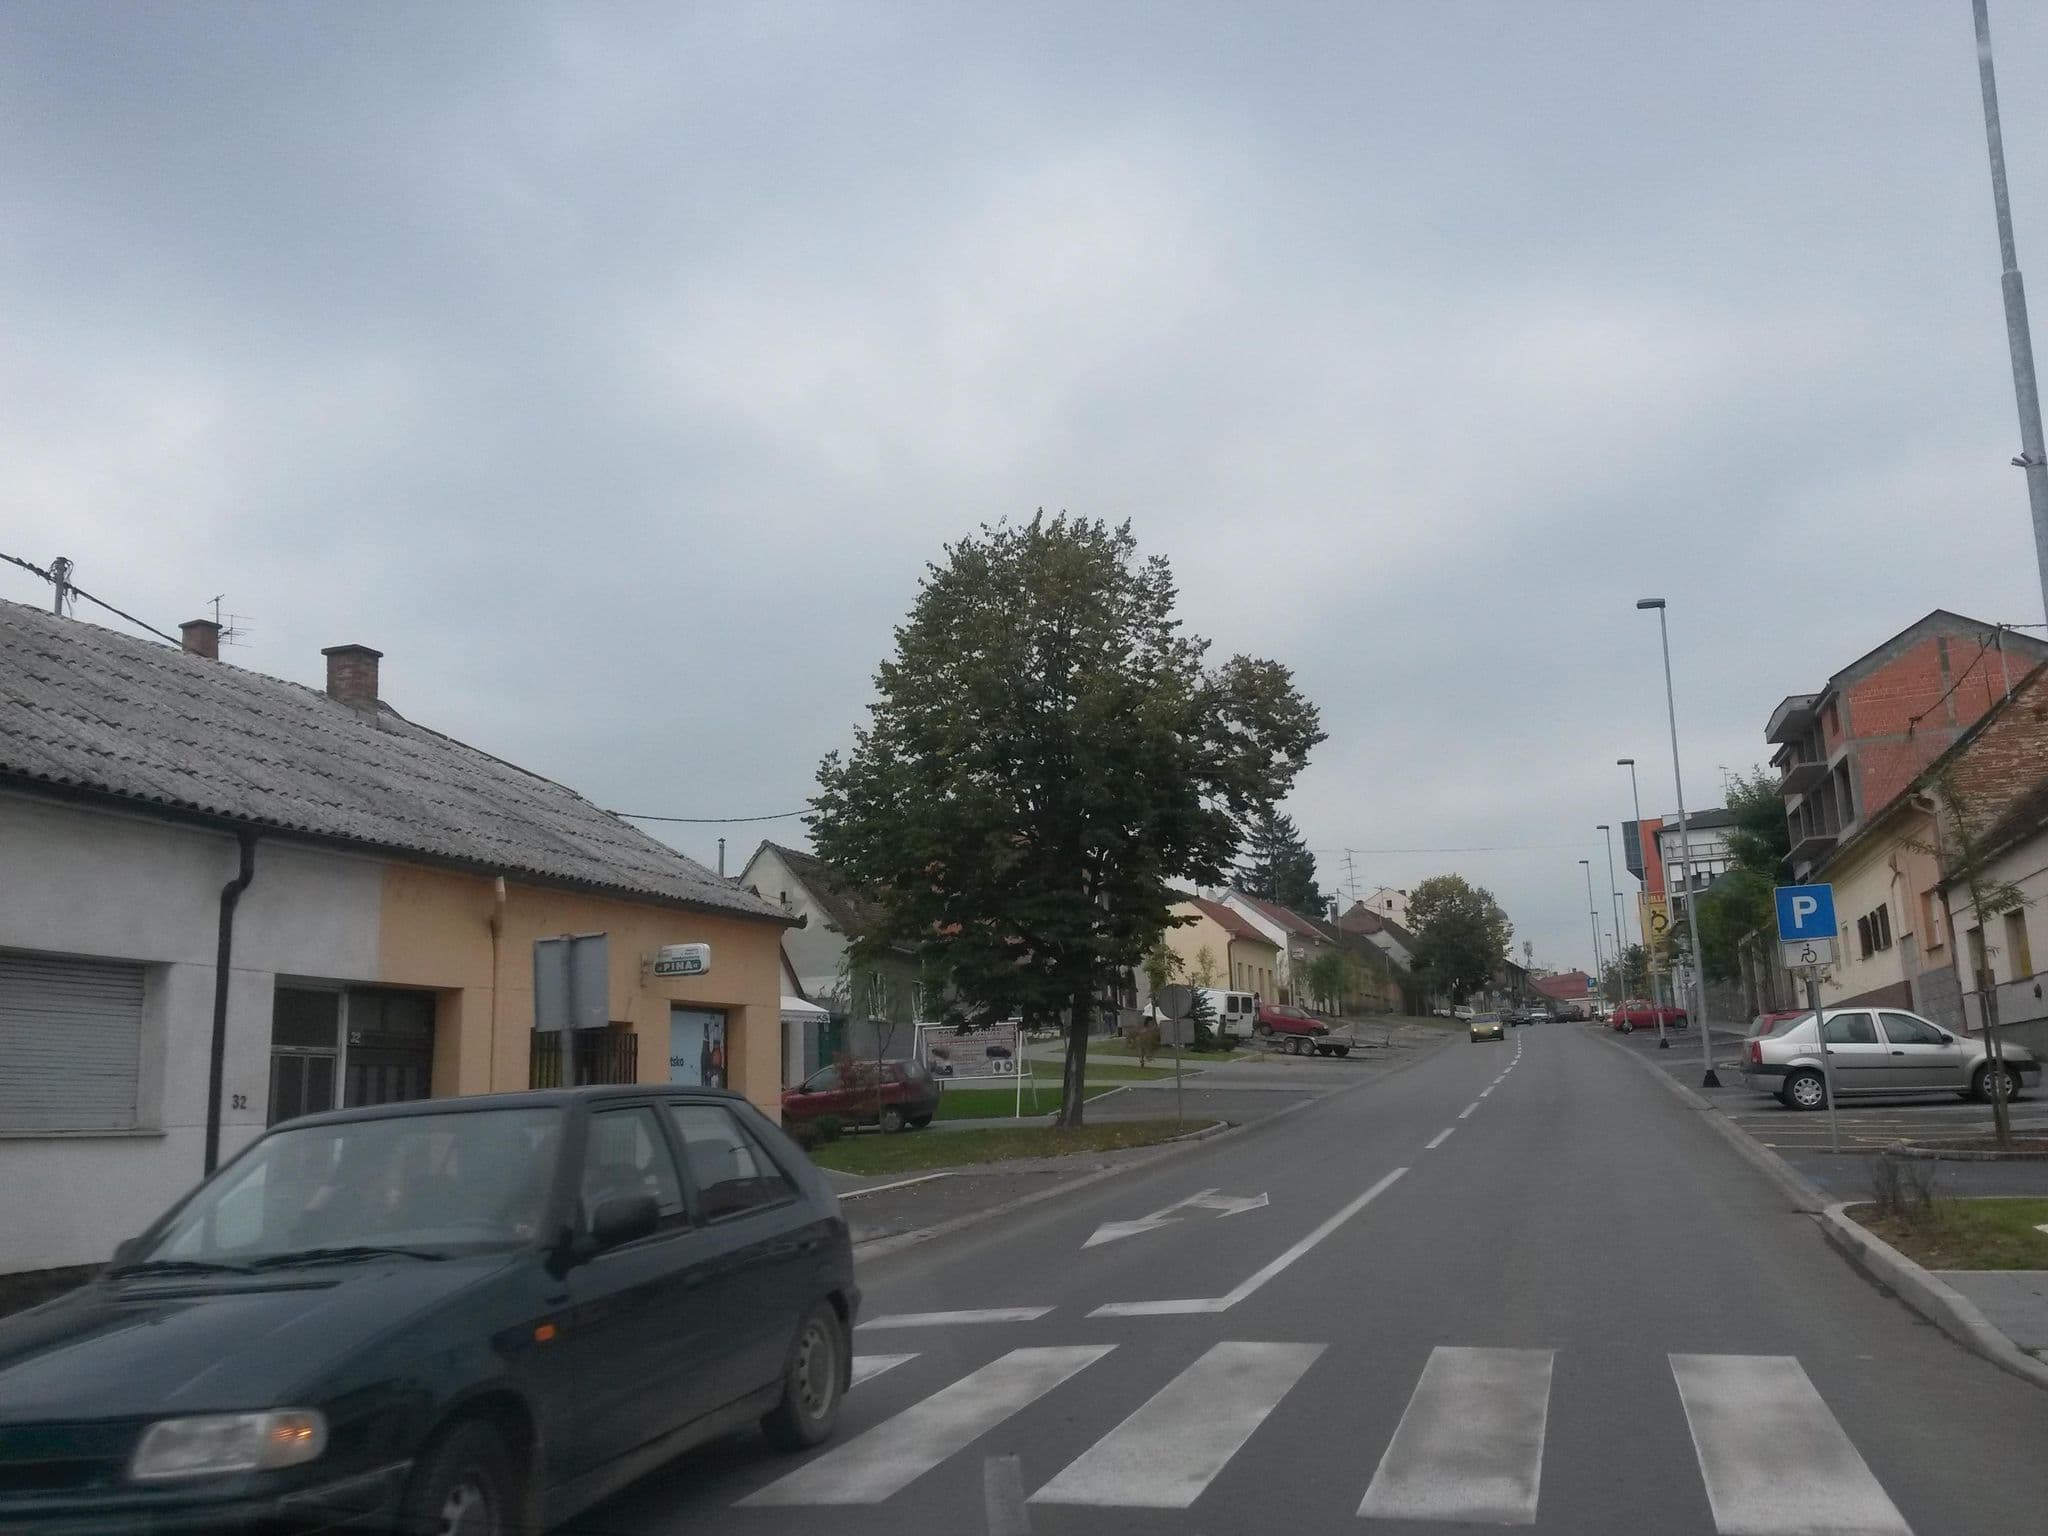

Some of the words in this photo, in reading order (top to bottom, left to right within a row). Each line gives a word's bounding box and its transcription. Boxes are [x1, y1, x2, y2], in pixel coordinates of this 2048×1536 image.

[1793, 896, 1818, 929] P
[348, 1031, 361, 1043] 32
[232, 1094, 247, 1110] 32
